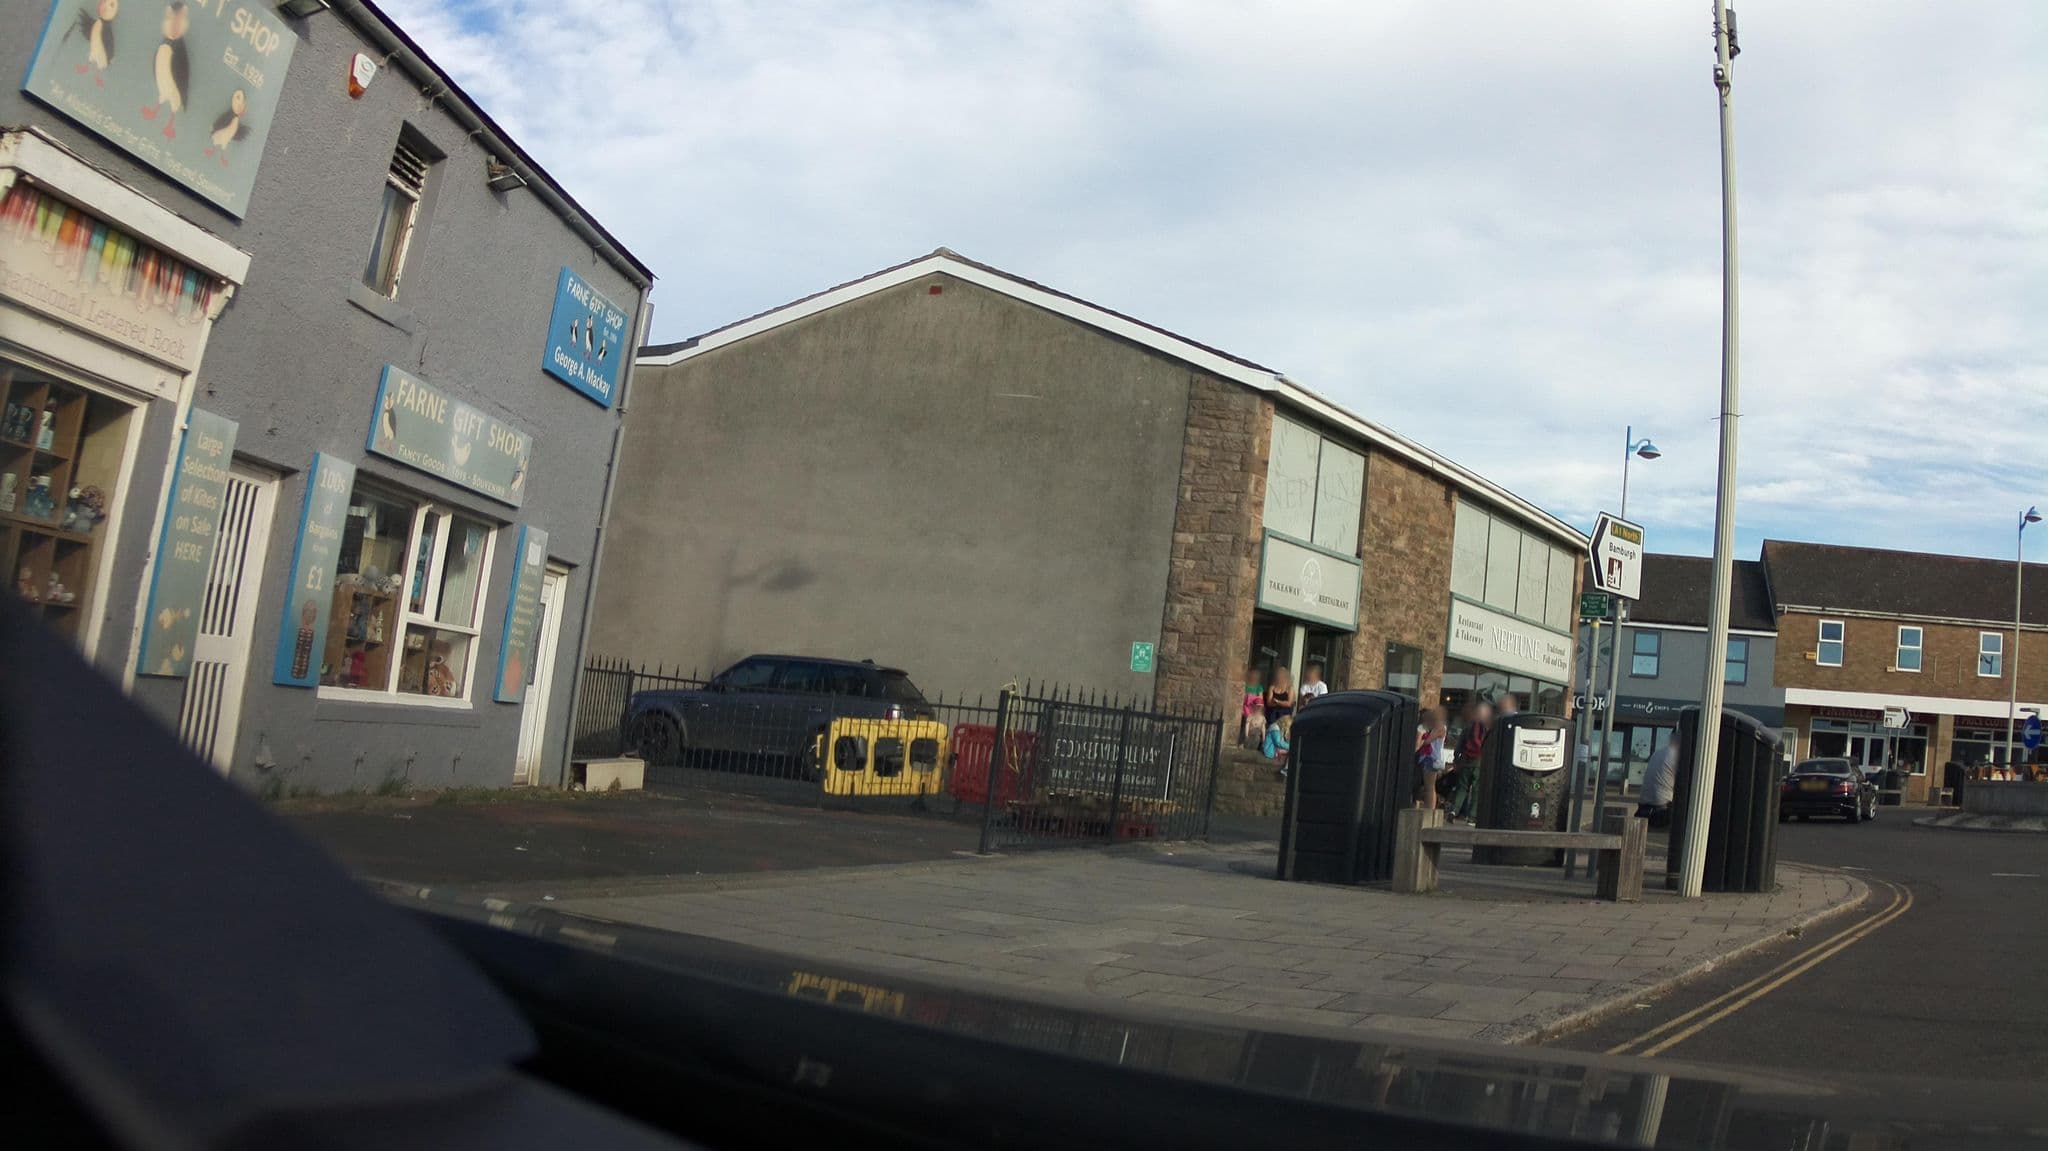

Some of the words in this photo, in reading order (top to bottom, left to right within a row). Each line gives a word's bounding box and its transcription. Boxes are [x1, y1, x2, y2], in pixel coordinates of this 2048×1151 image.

[230, 8, 280, 56] SHOP
[567, 277, 589, 306] FARNE
[589, 295, 606, 318] GIFT
[605, 309, 623, 331] SHOP
[554, 346, 578, 376] George
[577, 363, 586, 380] A.
[586, 367, 611, 399] Mackay
[397, 379, 449, 425] FARNE
[453, 407, 486, 441] GIFT
[488, 423, 523, 460] SHOP
[198, 431, 224, 457] Large
[182, 455, 227, 486] Selection
[320, 467, 346, 494] 100s
[174, 540, 203, 563] HERE
[1608, 541, 1637, 561] Bamburgh
[305, 565, 323, 591] £1
[1269, 579, 1300, 597] TAKEAWAY
[1318, 593, 1349, 611] RESTAURANT
[1458, 614, 1484, 631] Restaurant
[1461, 629, 1484, 647] Takeaway
[1490, 624, 1541, 663] NEPTUNE
